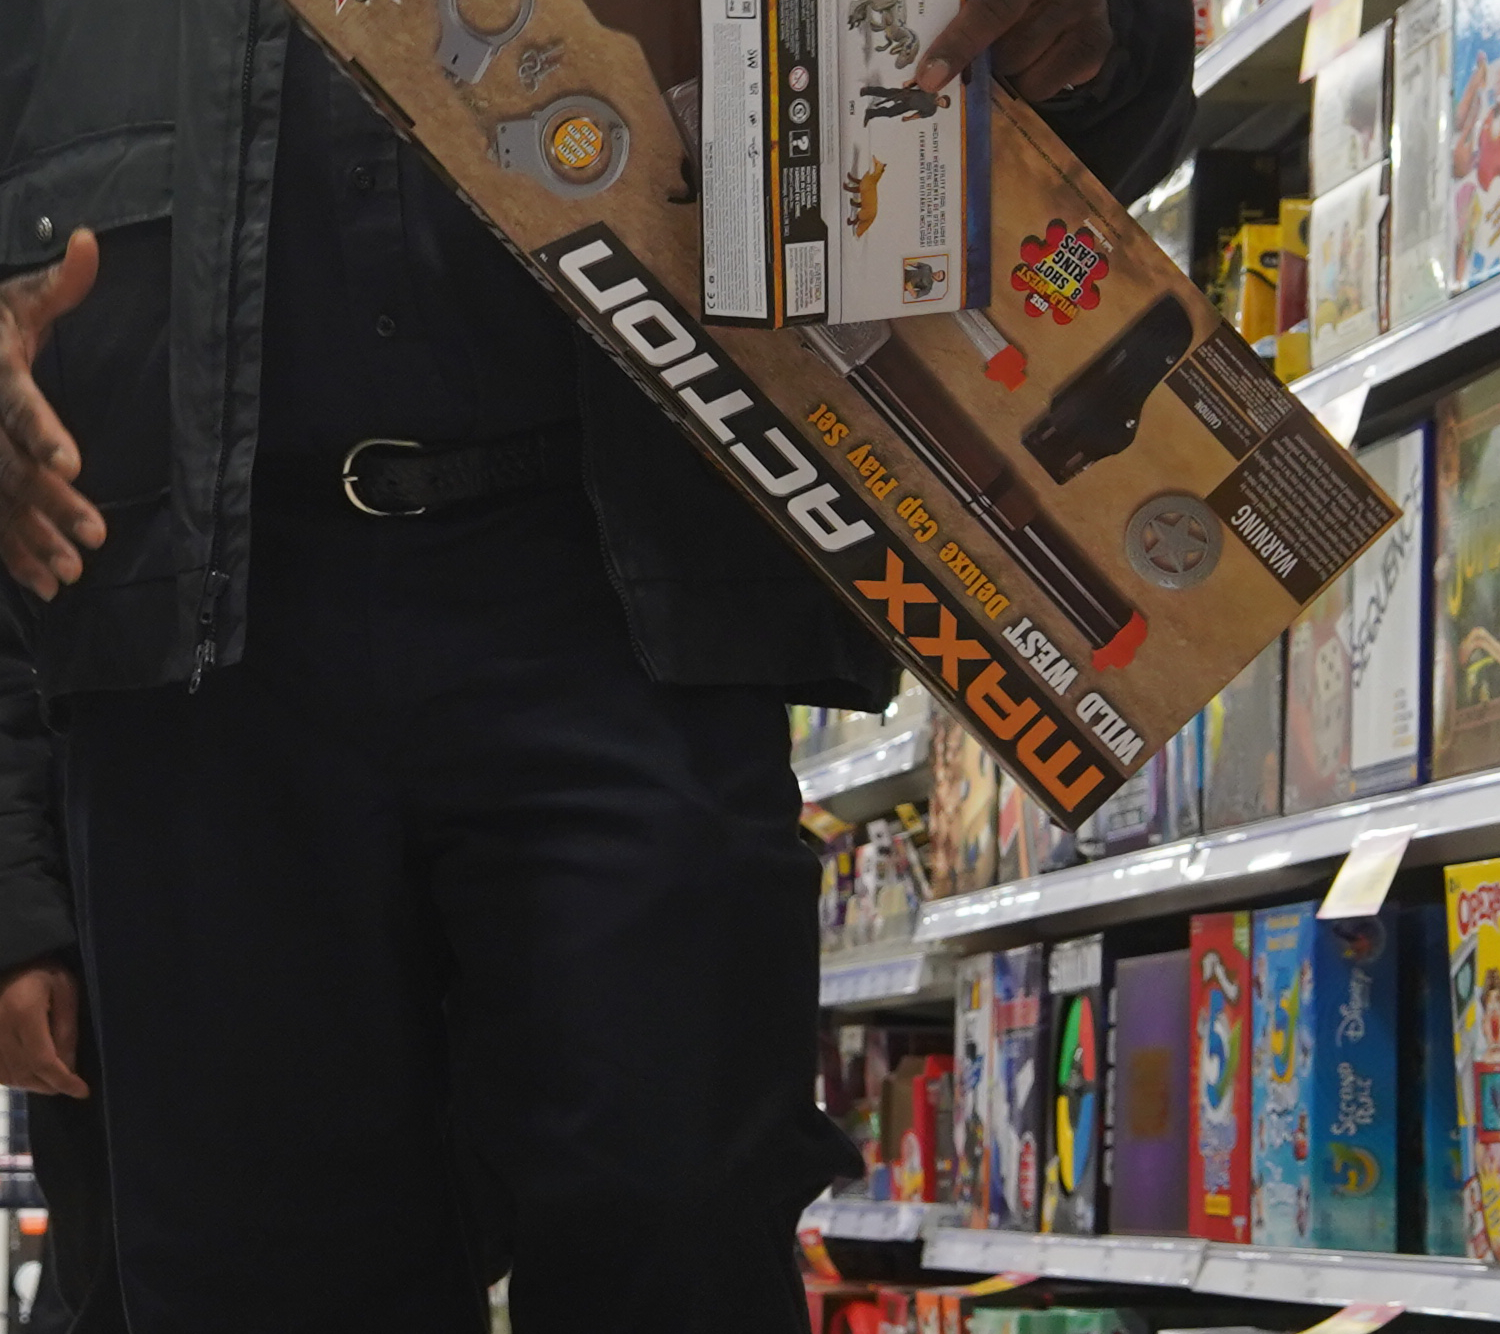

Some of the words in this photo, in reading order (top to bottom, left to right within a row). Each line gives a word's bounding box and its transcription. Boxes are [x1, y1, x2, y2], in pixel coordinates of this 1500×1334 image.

[1051, 246, 1090, 288] RING
[1061, 229, 1100, 272] CAPS
[1015, 263, 1049, 299] WEST
[1036, 256, 1070, 293] SHOT
[1068, 286, 1084, 301] 8
[1030, 292, 1051, 314] USE
[1046, 288, 1080, 324] WILD
[558, 240, 876, 553] ACTION
[1192, 397, 1223, 430] CAUTION:
[806, 402, 850, 448] Set
[847, 437, 900, 502] Play
[898, 497, 939, 543] Cap
[1229, 502, 1301, 579] WARNING
[939, 542, 1009, 619] Deluxe
[1353, 457, 1424, 689] SEQUENCE
[1003, 616, 1079, 695] WEST
[855, 548, 1105, 812] MAXX
[1078, 693, 1144, 766] WILD
[1337, 969, 1373, 1047] Disney
